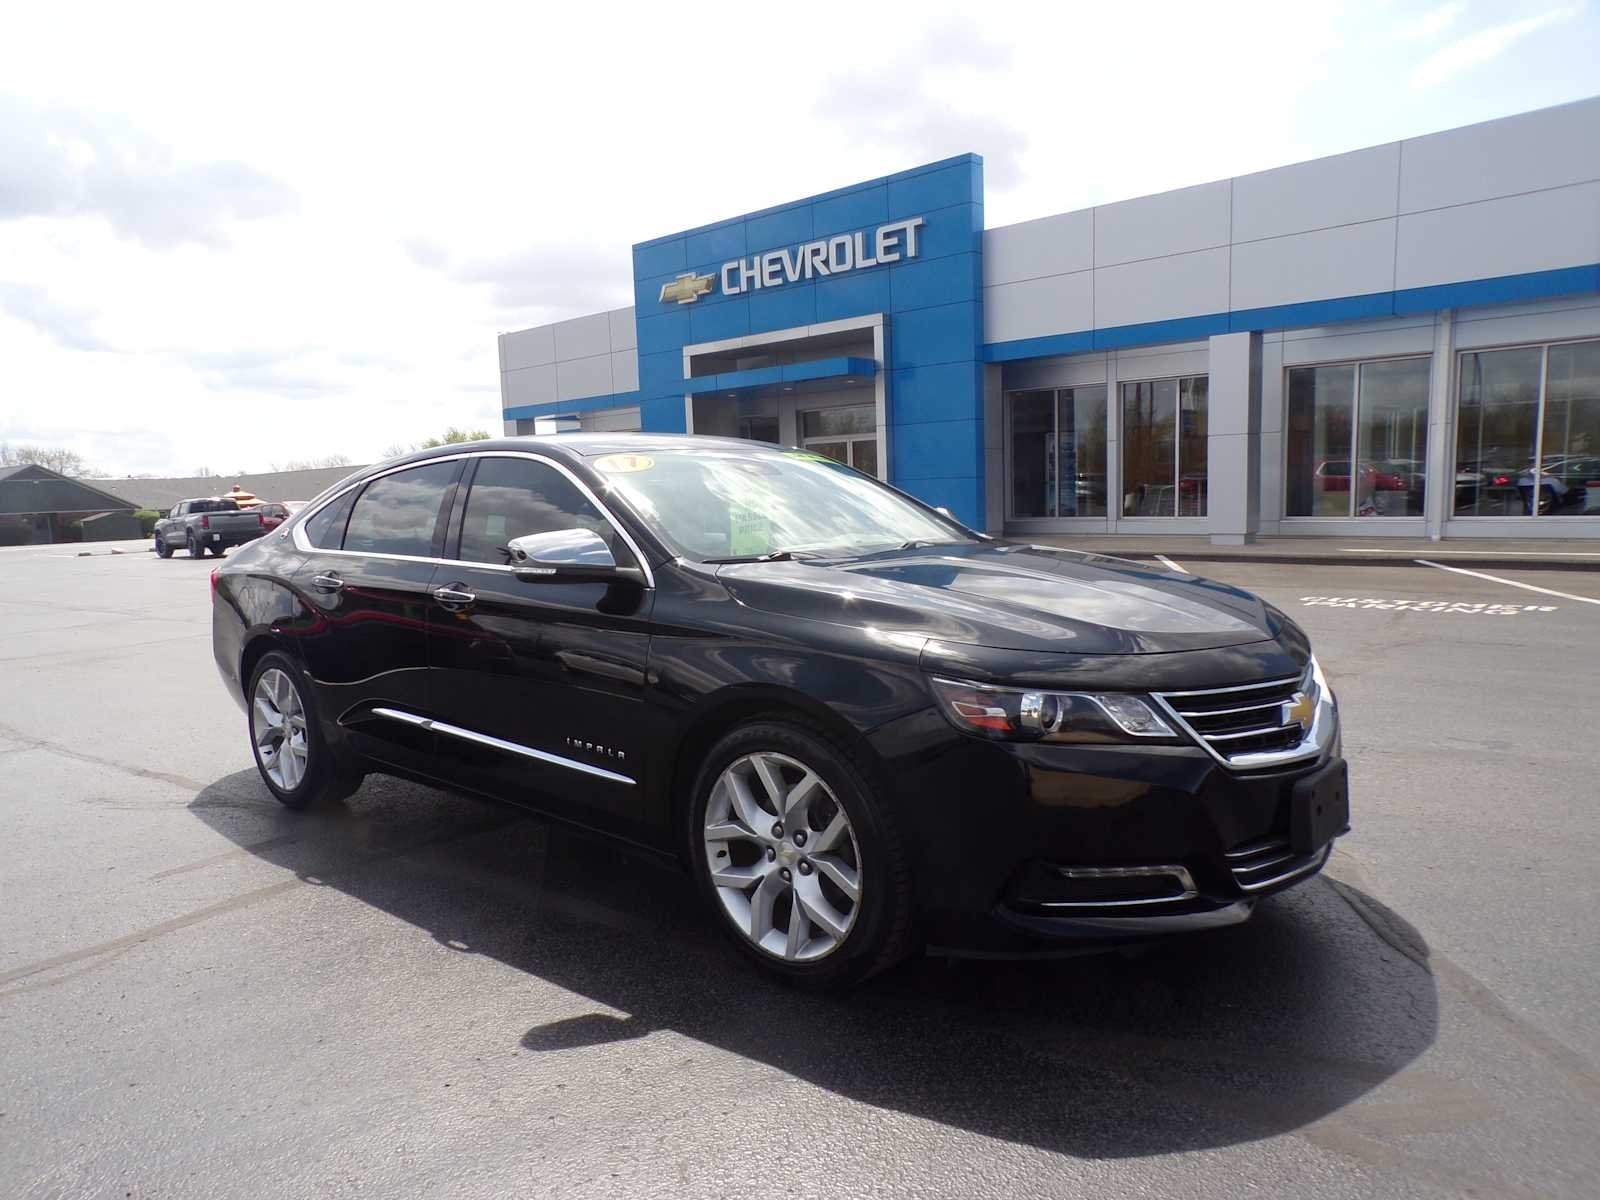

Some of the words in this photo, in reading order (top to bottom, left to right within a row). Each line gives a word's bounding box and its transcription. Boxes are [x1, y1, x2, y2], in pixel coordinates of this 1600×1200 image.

[721, 216, 926, 296] CHEVROLET
[1299, 596, 1558, 612] CUSTOMER
[1303, 601, 1521, 615] PARKING
[566, 737, 625, 759] IMPALA
